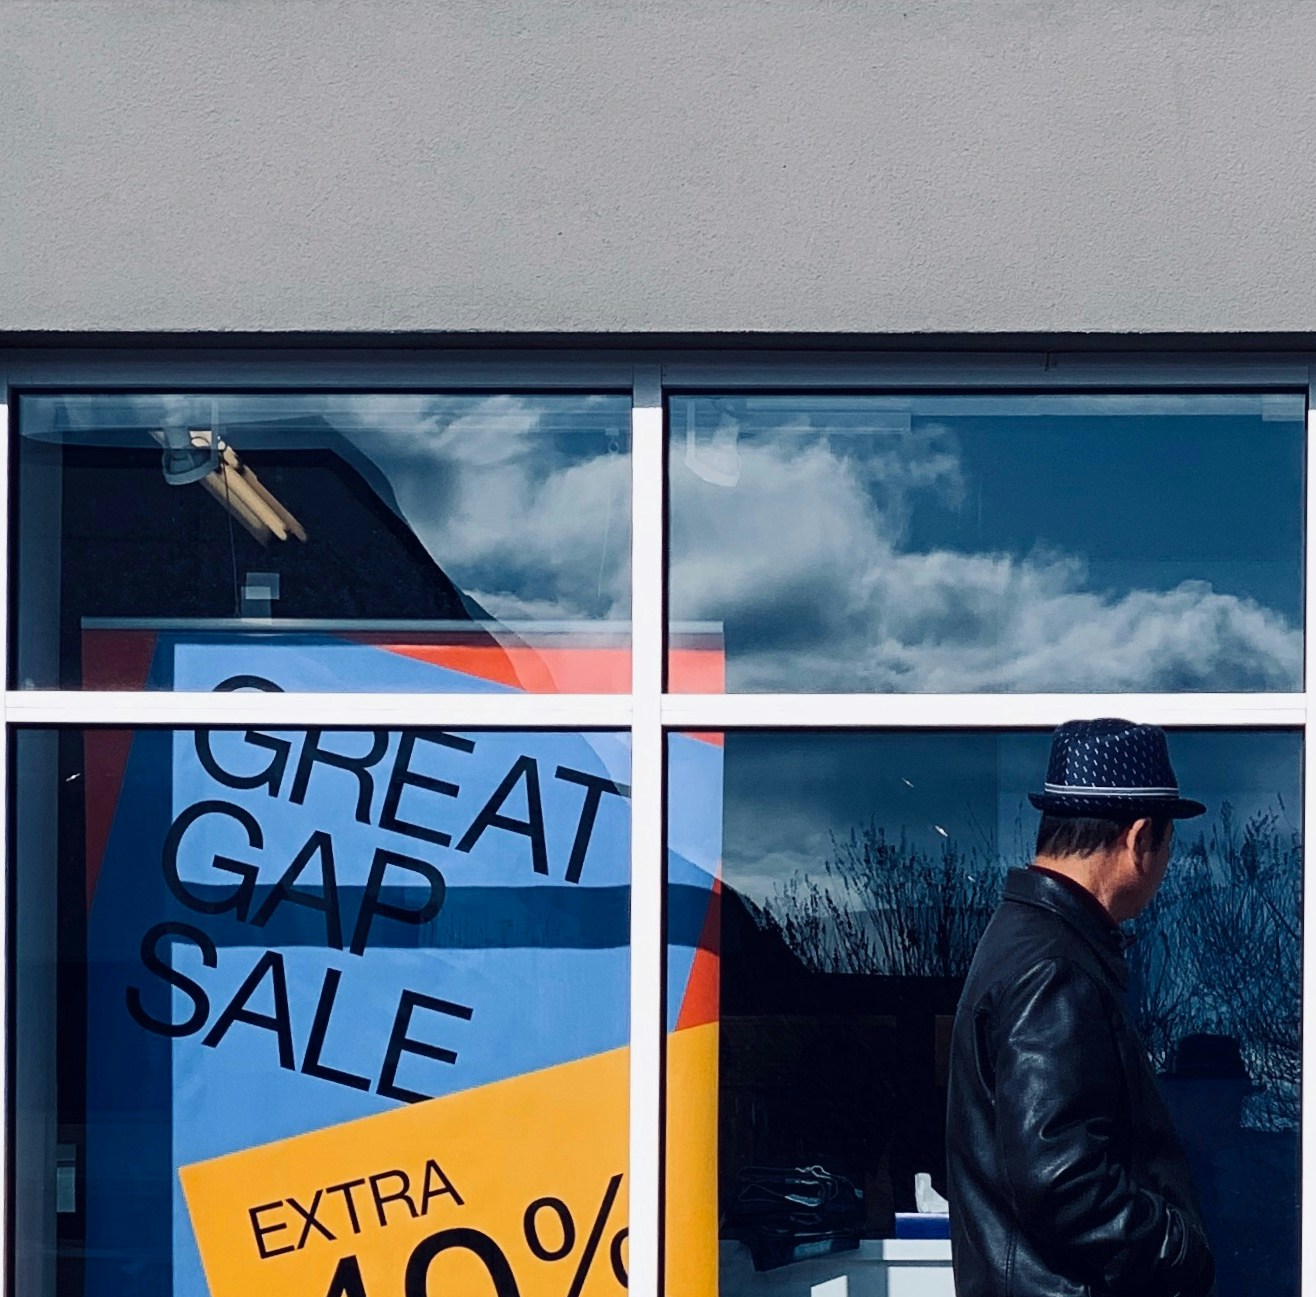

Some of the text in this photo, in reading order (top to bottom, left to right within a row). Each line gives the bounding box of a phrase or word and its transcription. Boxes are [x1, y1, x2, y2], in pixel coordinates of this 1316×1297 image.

[194, 675, 631, 885] GREAT
[161, 800, 447, 957] GAP
[125, 921, 474, 1105] SALE
[248, 1158, 465, 1260] EXTRA
